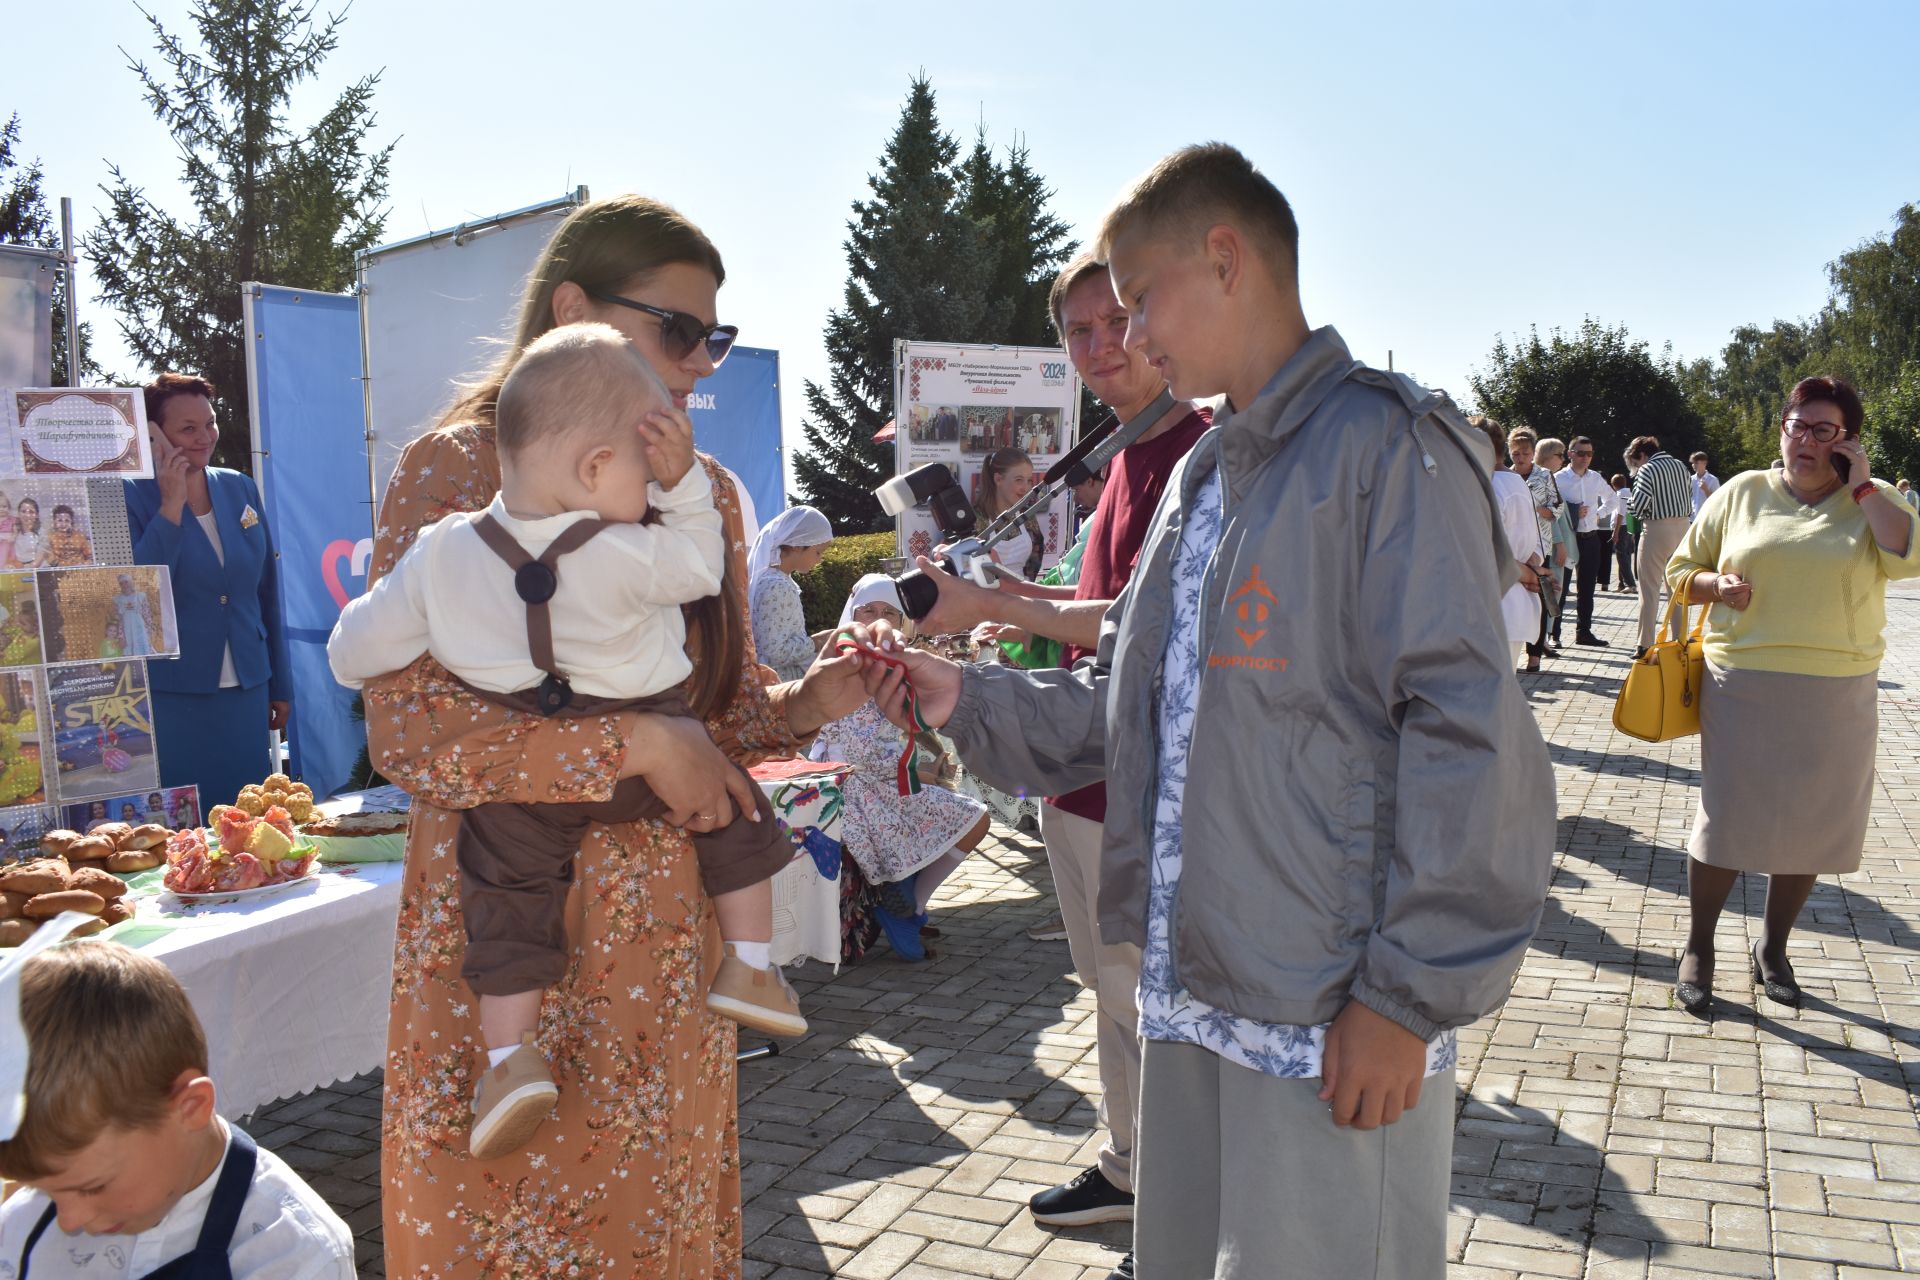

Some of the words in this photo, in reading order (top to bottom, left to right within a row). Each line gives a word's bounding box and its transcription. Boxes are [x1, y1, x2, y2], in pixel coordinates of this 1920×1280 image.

[1043, 362, 1066, 379] 2024
[36, 418, 93, 428] Творчество
[38, 430, 126, 442] Шарафутдиновых
[1208, 655, 1287, 672] ФОРПОСТ
[63, 674, 116, 686] ВСЕРОССИЙСКИЙ
[64, 695, 144, 728] STAR
